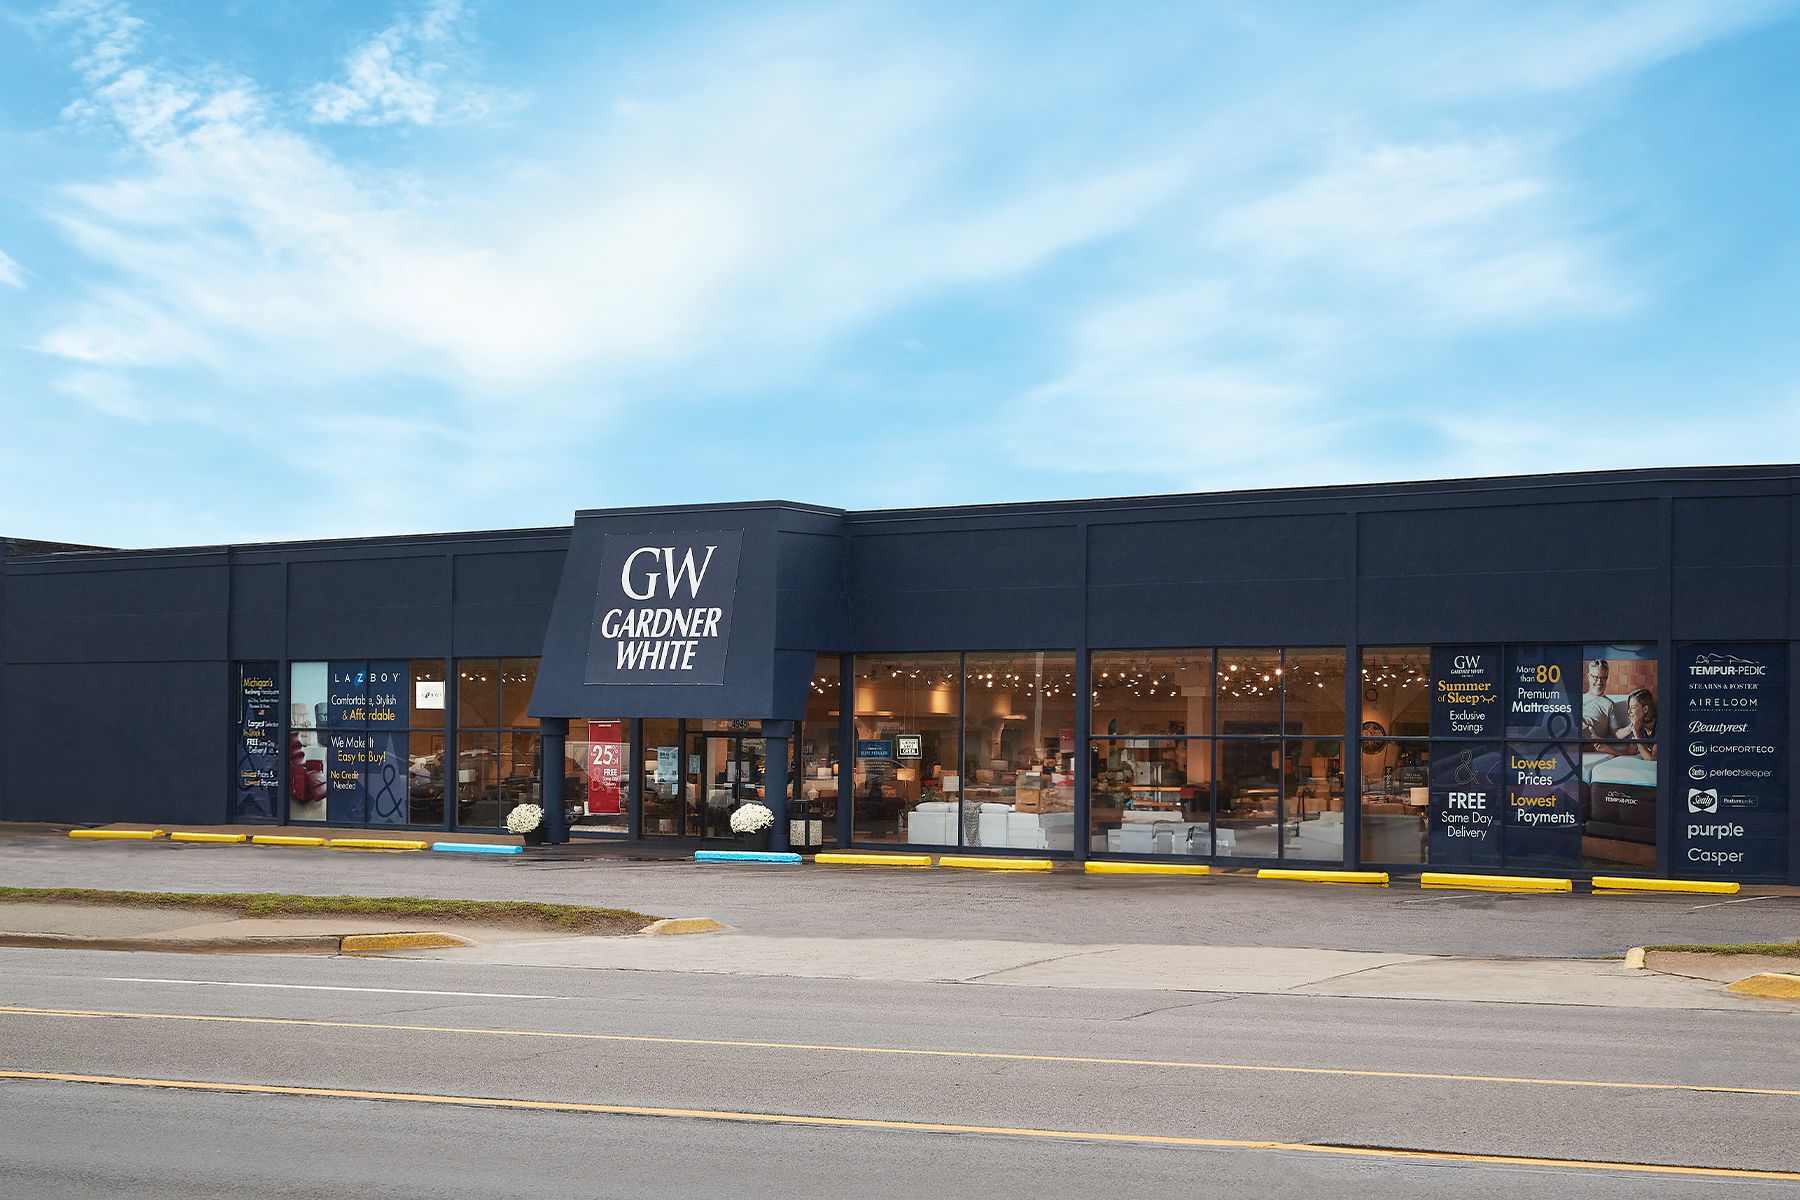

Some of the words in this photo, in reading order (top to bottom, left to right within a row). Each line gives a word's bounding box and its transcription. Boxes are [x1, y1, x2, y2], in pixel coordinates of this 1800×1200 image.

[620, 545, 718, 601] GW
[601, 607, 722, 639] GARDNER
[616, 640, 699, 670] WHITE
[1454, 655, 1481, 669] GW
[1516, 665, 1536, 674] More
[1536, 664, 1562, 684] 80
[1689, 665, 1767, 675] TEMPUR-PEDIC
[1520, 674, 1536, 683] than
[1438, 680, 1491, 692] Summer
[331, 693, 374, 707] Comfortabe,
[375, 693, 397, 708] Stylish
[1437, 693, 1447, 703] of
[1447, 692, 1480, 706] Sleep
[1518, 687, 1560, 700] Premium
[1511, 701, 1572, 714] Mattresses
[1689, 698, 1758, 707] AIRELOOM
[342, 709, 348, 721] &
[1449, 710, 1486, 721] Exclusive
[731, 720, 748, 729] 4945
[1451, 722, 1484, 735] Savings
[1688, 720, 1748, 735] Beautyrest
[331, 736, 345, 748] We
[345, 735, 366, 748] Make
[369, 736, 375, 748] It
[338, 750, 356, 766] Easy
[357, 752, 366, 762] to
[368, 750, 386, 766] Buy!
[1511, 755, 1557, 770] Lowest
[330, 770, 341, 779] No
[341, 770, 359, 780] Credit
[603, 768, 618, 777] FREE
[1517, 771, 1553, 786] Prices
[1448, 792, 1487, 810] FREE
[1510, 792, 1557, 807] Lowest
[1692, 794, 1713, 807] Sealy
[1441, 810, 1470, 824] Same
[1472, 811, 1493, 826] Day
[1517, 809, 1576, 826] Payments
[1447, 826, 1487, 842] Delivery
[1687, 822, 1744, 840] purple
[1687, 848, 1745, 866] Casper
